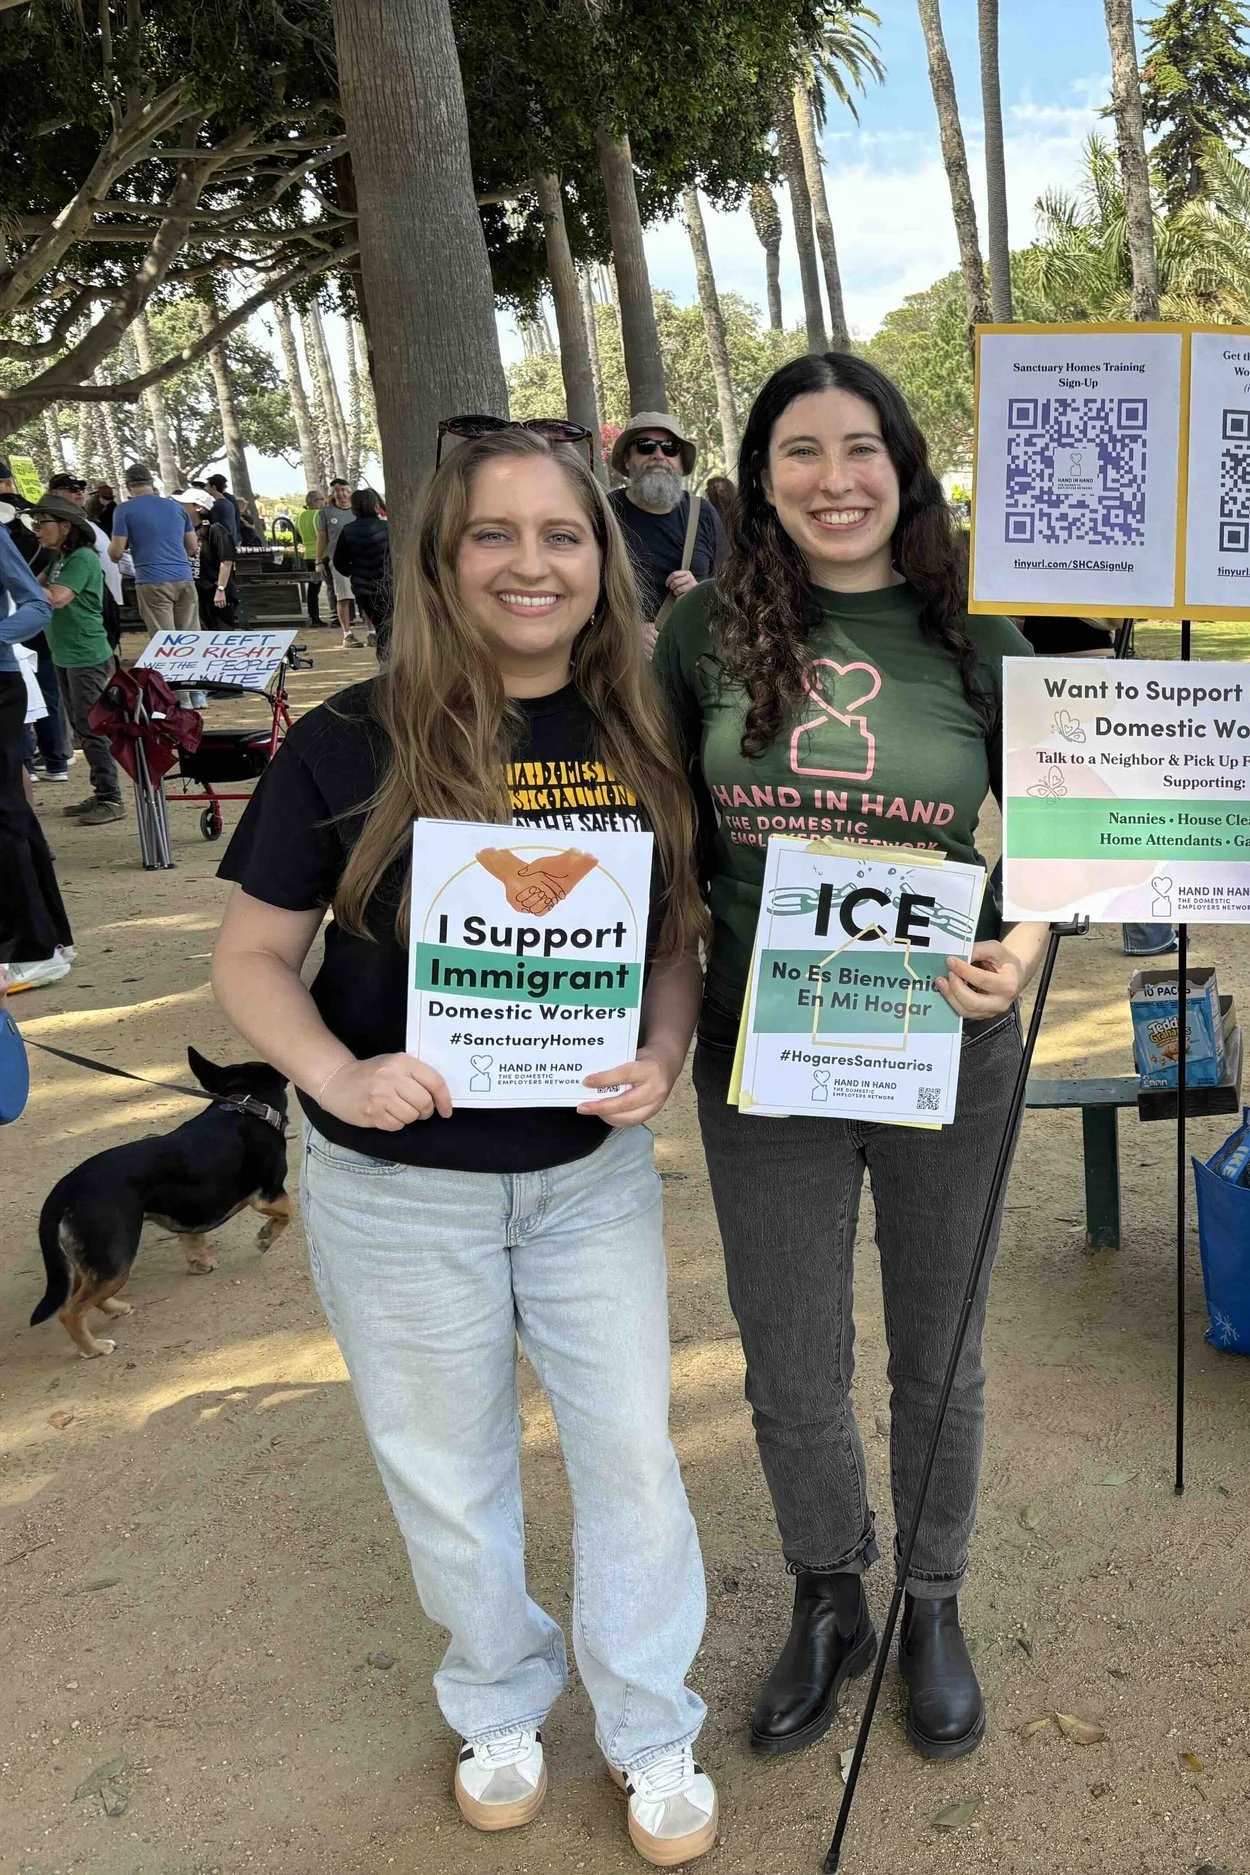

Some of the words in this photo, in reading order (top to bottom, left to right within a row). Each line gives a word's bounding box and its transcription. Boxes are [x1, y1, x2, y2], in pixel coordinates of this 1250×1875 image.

[1223, 351, 1241, 361] Get
[1013, 362, 1063, 374] Sanctuary
[1066, 362, 1101, 372] Homes
[1103, 362, 1146, 374] Training
[1058, 378, 1099, 389] Sign-Up
[1013, 558, 1135, 572] tinyurl.com/SHCASignUp
[162, 634, 200, 646] NO
[210, 634, 276, 646] LEFT
[154, 646, 194, 658] NO
[202, 646, 281, 659] RIGHT
[143, 661, 165, 670] WE
[168, 661, 198, 671] THE
[206, 659, 280, 672] PEOPLE
[1044, 678, 1109, 700] Want
[1115, 681, 1139, 700] to
[1146, 680, 1243, 707] Support
[1095, 717, 1207, 739] Domestic
[1035, 751, 1068, 765] Talk
[1071, 753, 1084, 765] to
[1088, 756, 1097, 765] a
[1099, 753, 1164, 769] Neighbor
[1168, 755, 1180, 766] &
[1183, 754, 1215, 767] Pick
[1219, 755, 1239, 770] Up
[1162, 775, 1246, 791] Supporting:
[713, 784, 802, 808] HAND
[814, 789, 848, 812] IN
[861, 793, 955, 826] HAND
[725, 815, 751, 831] THE
[757, 816, 869, 835] DOMESTIC
[1109, 812, 1166, 825] Nannies
[1177, 813, 1222, 826] House
[1100, 833, 1143, 846] Home
[1145, 833, 1223, 847] Attendants
[1178, 887, 1210, 896] HAND
[1212, 887, 1224, 896] IN
[814, 883, 936, 948] ICE
[439, 914, 448, 944] I
[463, 916, 626, 956] Support
[430, 958, 629, 998] Immigrant
[772, 961, 801, 981] No
[808, 964, 832, 982] Es
[428, 1001, 532, 1020] Domestic
[539, 1004, 626, 1020] Workers
[797, 989, 824, 1008] En
[830, 991, 858, 1011] Mi
[864, 994, 933, 1019] Hogar
[1147, 1015, 1179, 1034] Tedd
[450, 1032, 605, 1049] #SanctuaryHomes
[499, 1063, 532, 1072] HAND
[536, 1063, 547, 1072] IN
[550, 1063, 583, 1072] HAND
[780, 1049, 933, 1072] #HogaresSantuarios
[834, 1079, 859, 1088] HAND
[861, 1080, 870, 1088] IN
[872, 1081, 897, 1090] HAND
